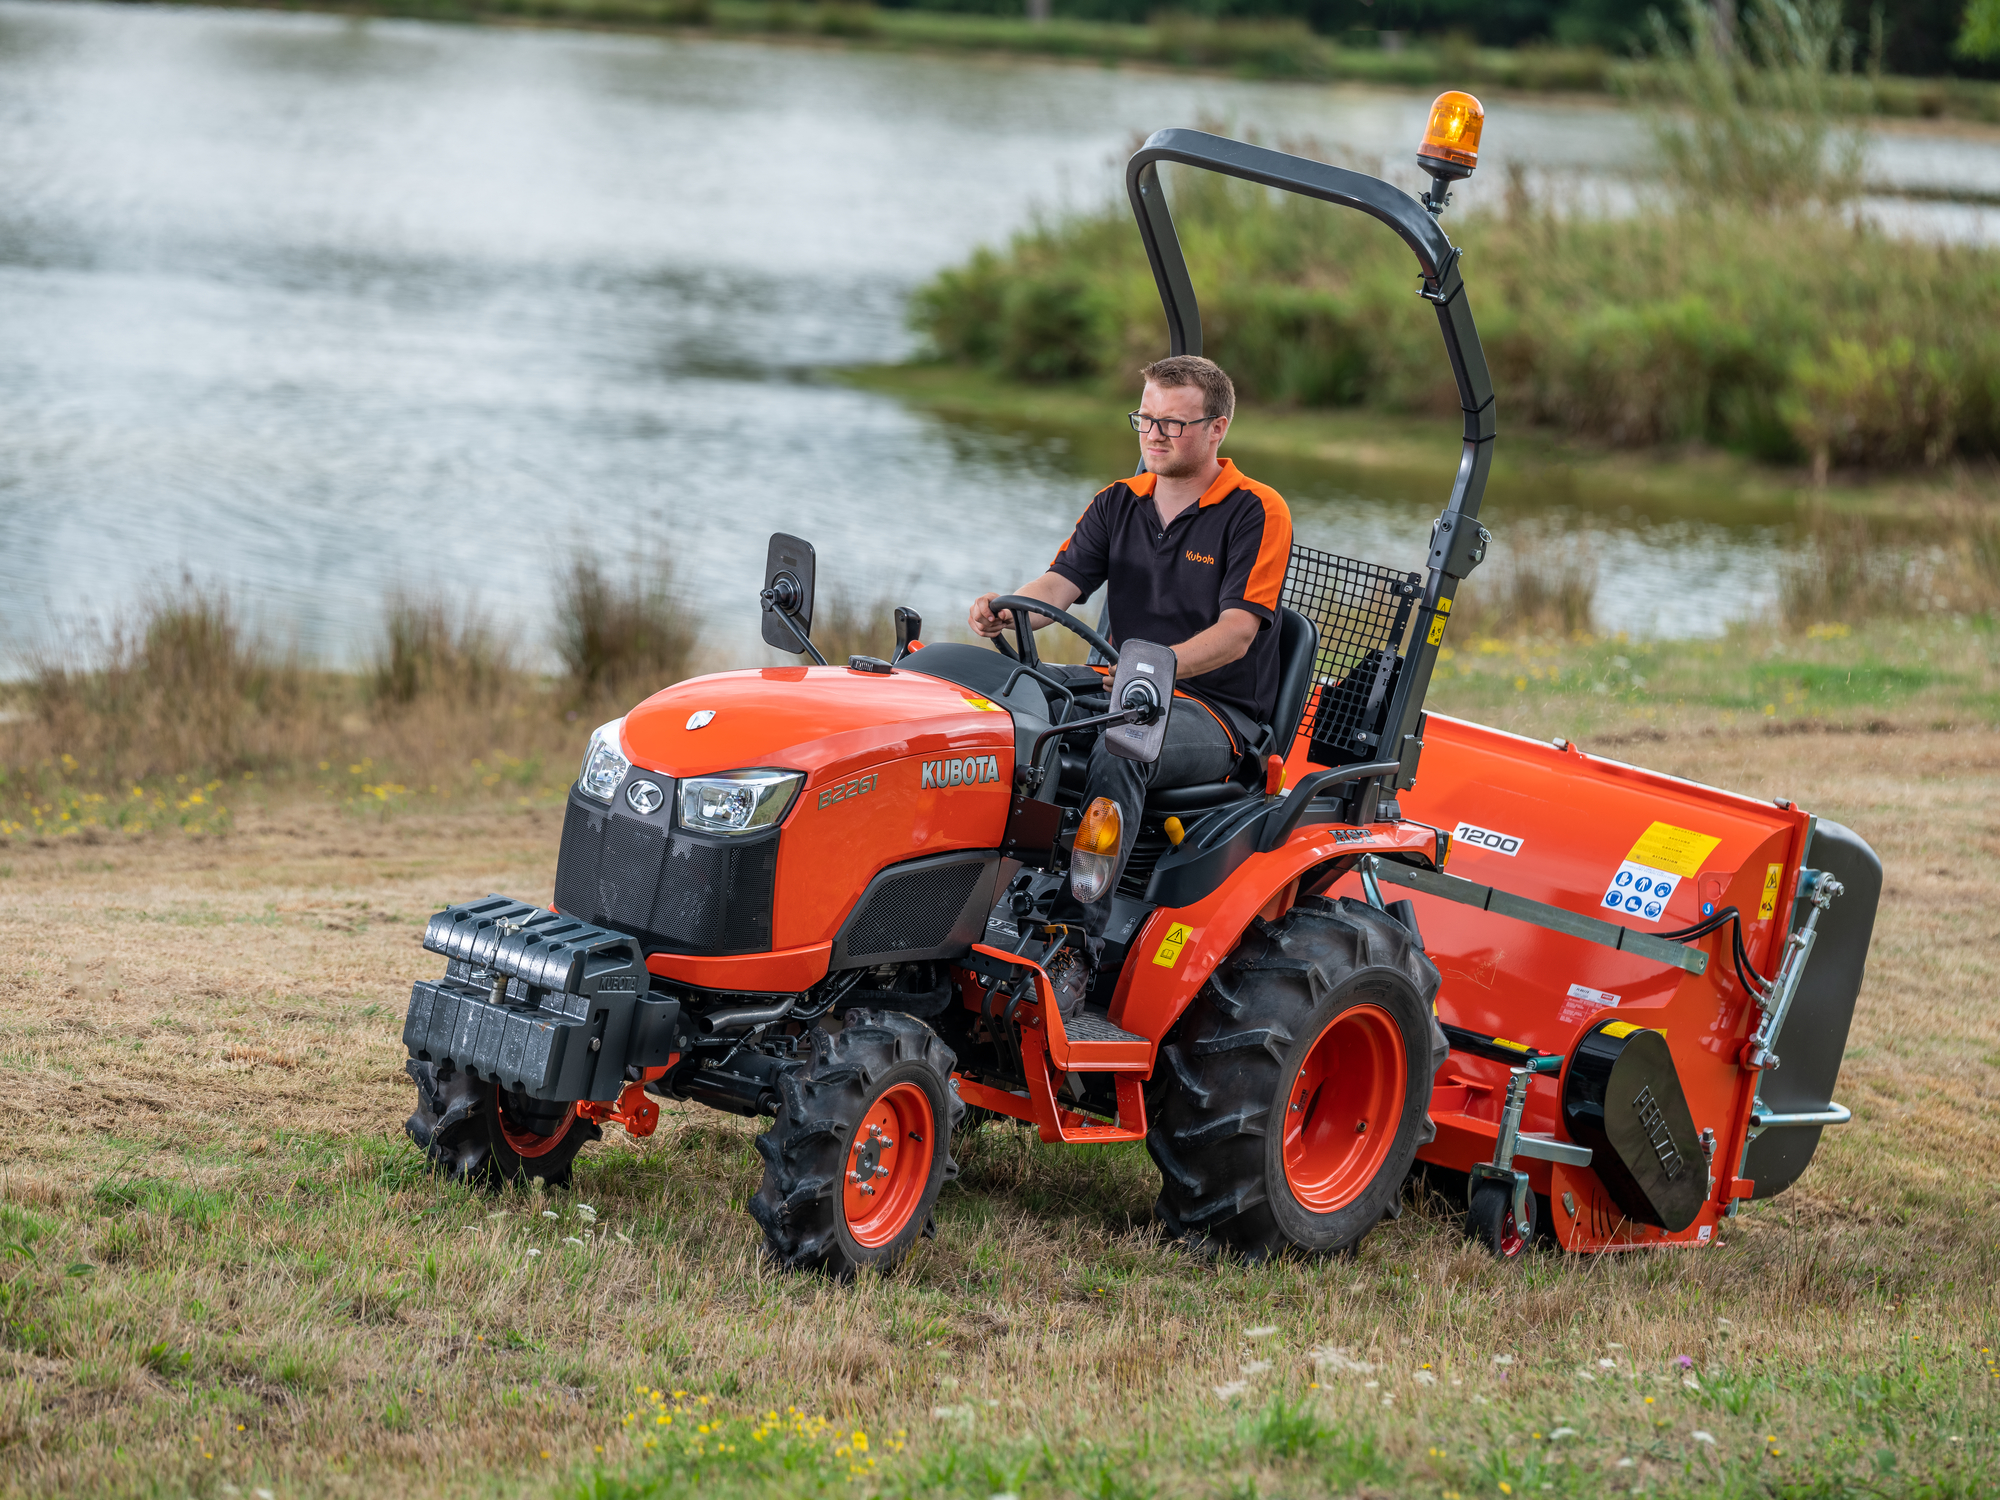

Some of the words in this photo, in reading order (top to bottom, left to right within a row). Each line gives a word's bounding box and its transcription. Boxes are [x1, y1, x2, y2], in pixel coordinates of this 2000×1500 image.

[1185, 550, 1215, 565] Kubota
[921, 754, 1000, 790] KUBOTA
[817, 773, 879, 811] B2261
[1328, 829, 1376, 845] HST
[1459, 827, 1519, 852] 1200
[599, 975, 638, 991] KUBOTA
[1632, 1085, 1684, 1182] PERUZZO
